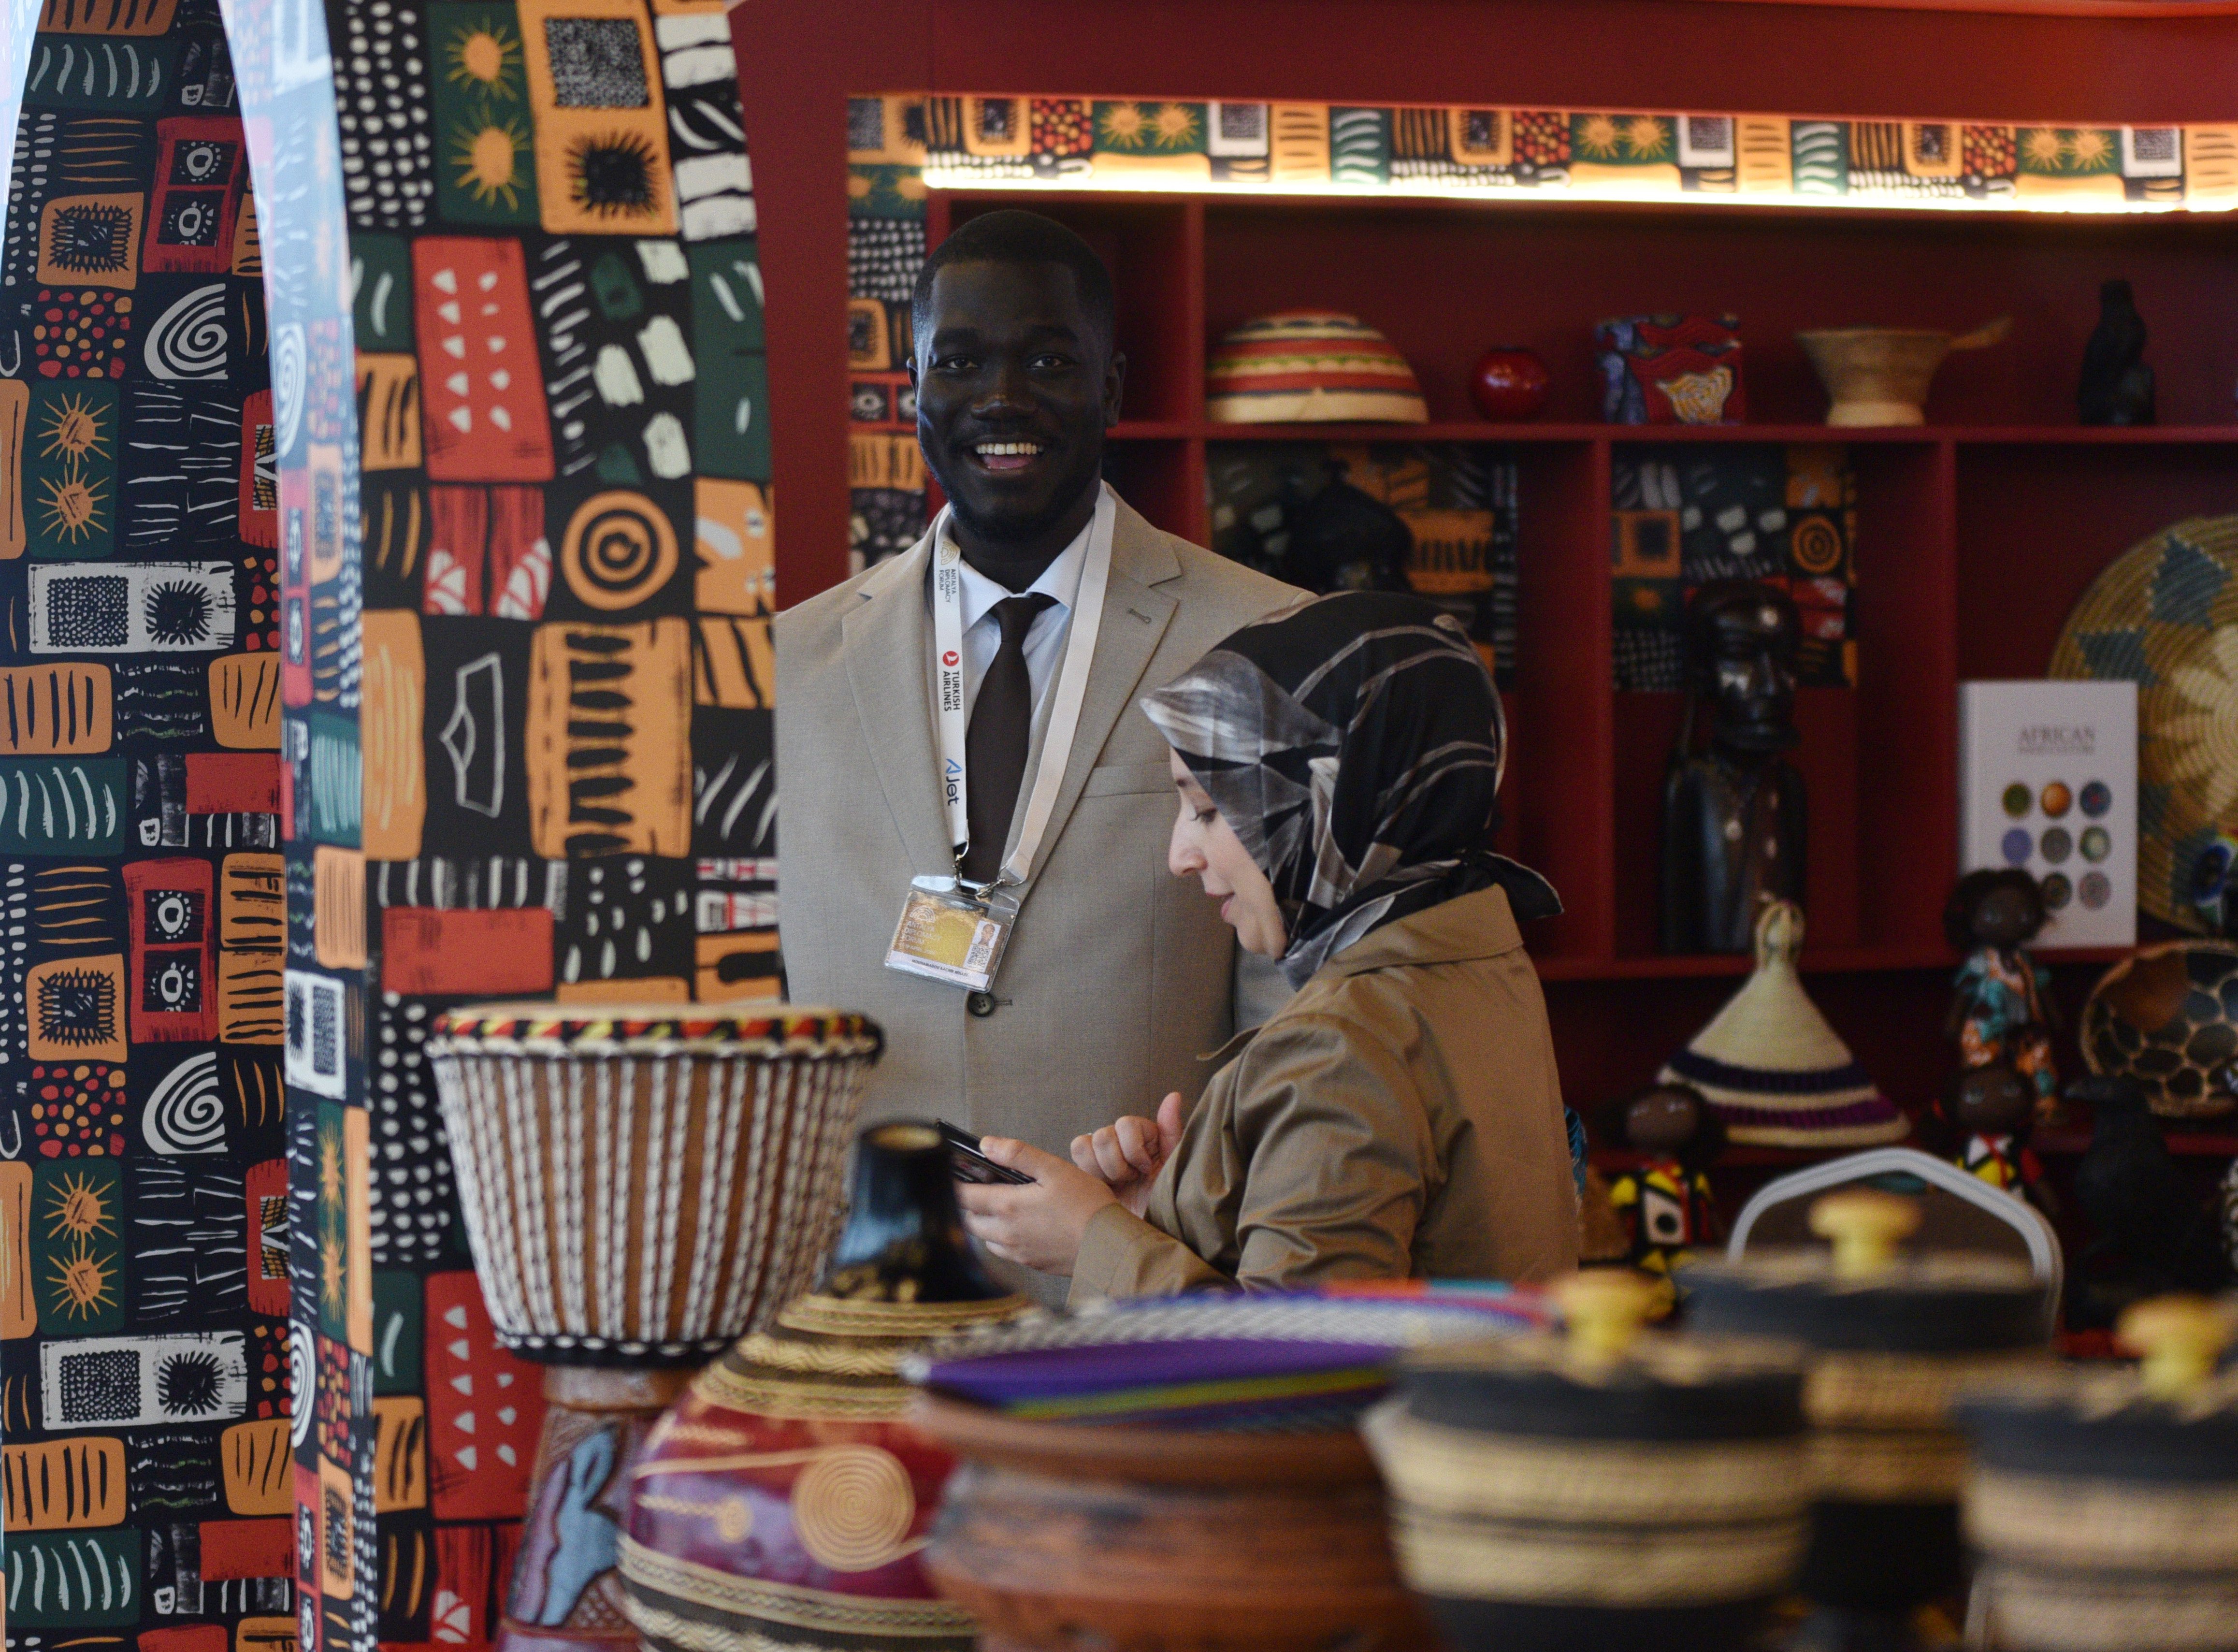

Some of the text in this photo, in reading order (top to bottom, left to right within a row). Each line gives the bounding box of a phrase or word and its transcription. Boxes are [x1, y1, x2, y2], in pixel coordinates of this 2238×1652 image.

[943, 671, 952, 711] AIRLINES
[952, 670, 960, 710] TURKISH
[908, 921, 935, 932] ANTALYA
[902, 934, 924, 944] FORUM
[904, 928, 941, 941] DIPLOMACY
